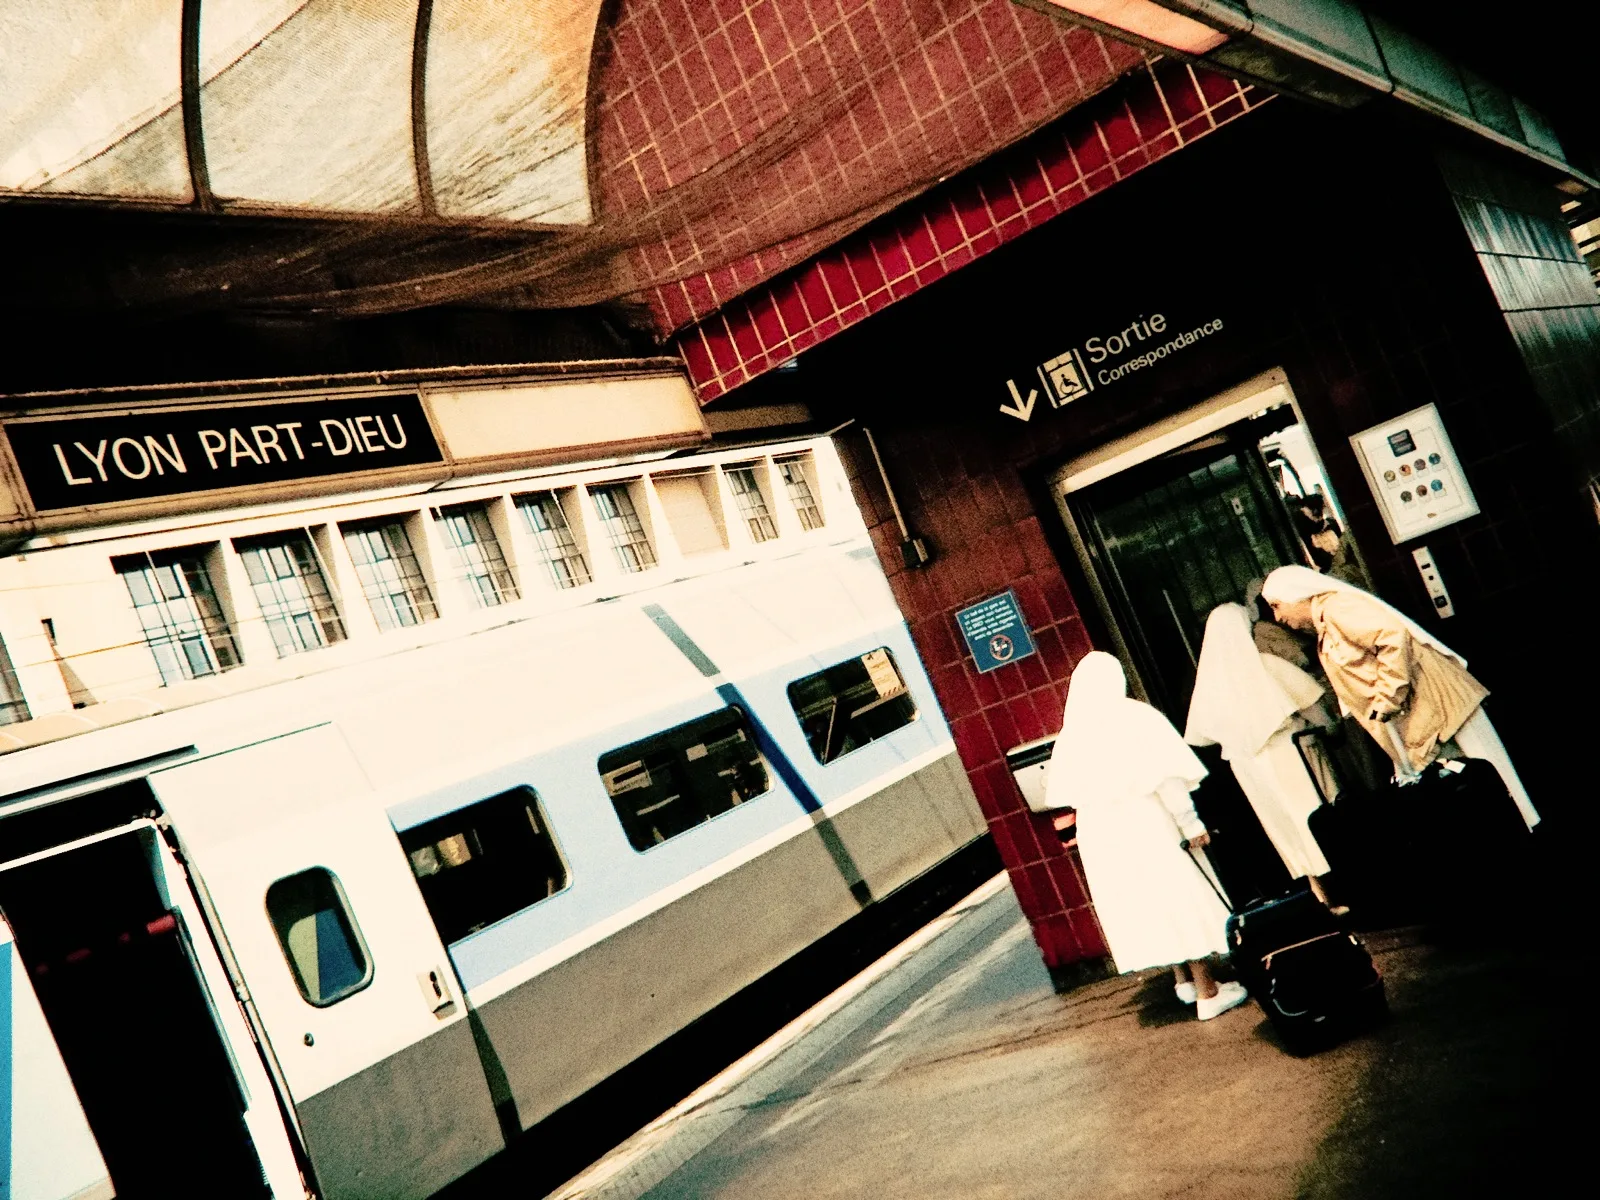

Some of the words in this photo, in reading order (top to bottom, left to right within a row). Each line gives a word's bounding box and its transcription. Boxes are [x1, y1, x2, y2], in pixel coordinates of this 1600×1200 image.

[1085, 313, 1167, 363] Sortie
[1097, 318, 1224, 385] Correspondance
[53, 433, 187, 486] LYON
[198, 413, 408, 470] PART-DIEU
